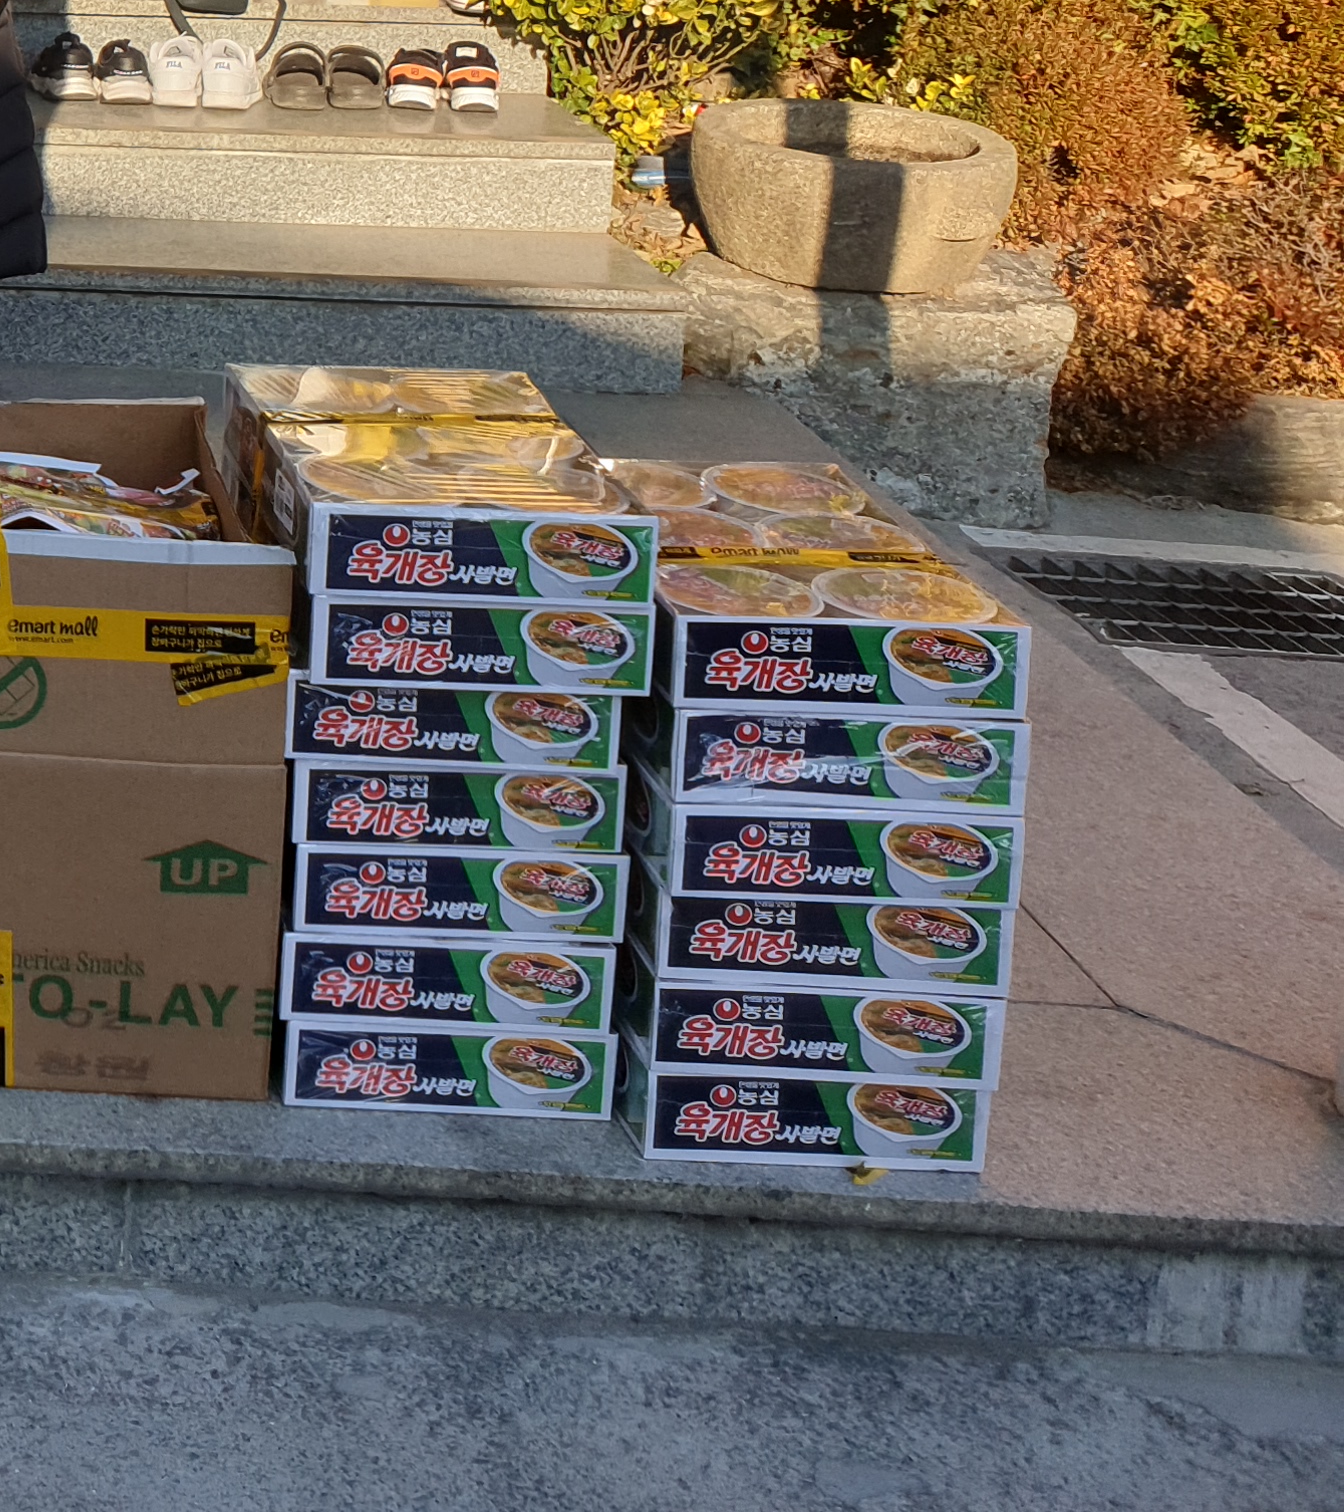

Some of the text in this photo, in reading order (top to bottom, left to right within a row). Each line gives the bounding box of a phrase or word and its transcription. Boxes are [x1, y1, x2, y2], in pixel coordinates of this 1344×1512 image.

[412, 527, 454, 545] 농심
[348, 540, 518, 586] 육개장 사발면
[8, 616, 99, 637] emart mall
[411, 617, 452, 635] 농심
[197, 638, 222, 649] 집으로
[347, 630, 452, 675] 육개장
[769, 634, 812, 653] 농심
[705, 648, 878, 694] 육개장 사발면
[377, 694, 417, 711] 농심
[314, 706, 480, 751] 육개장 사발면
[763, 725, 806, 745] 농심
[702, 739, 806, 785] 육개장
[388, 781, 428, 799] 농심
[326, 794, 490, 837] 육개장 사발면
[768, 827, 810, 847] 농심
[170, 858, 238, 886] UP
[387, 866, 427, 884] 농심
[703, 841, 874, 887] 육개장 사발면
[325, 878, 488, 922] 육개장 사발면
[754, 907, 797, 926] 농심
[688, 920, 862, 966] 육개장 사발면
[76, 951, 145, 977] Snacks
[375, 956, 415, 973] 농심
[312, 967, 475, 1011] 육개장 사발면
[742, 1001, 784, 1021] 농심
[677, 1014, 849, 1061] 육개장 사발면
[377, 1042, 417, 1060] 농심
[315, 1054, 477, 1097] 육개장 사발면
[738, 1088, 779, 1106] 농심
[674, 1101, 842, 1146] 육개장 사발면
